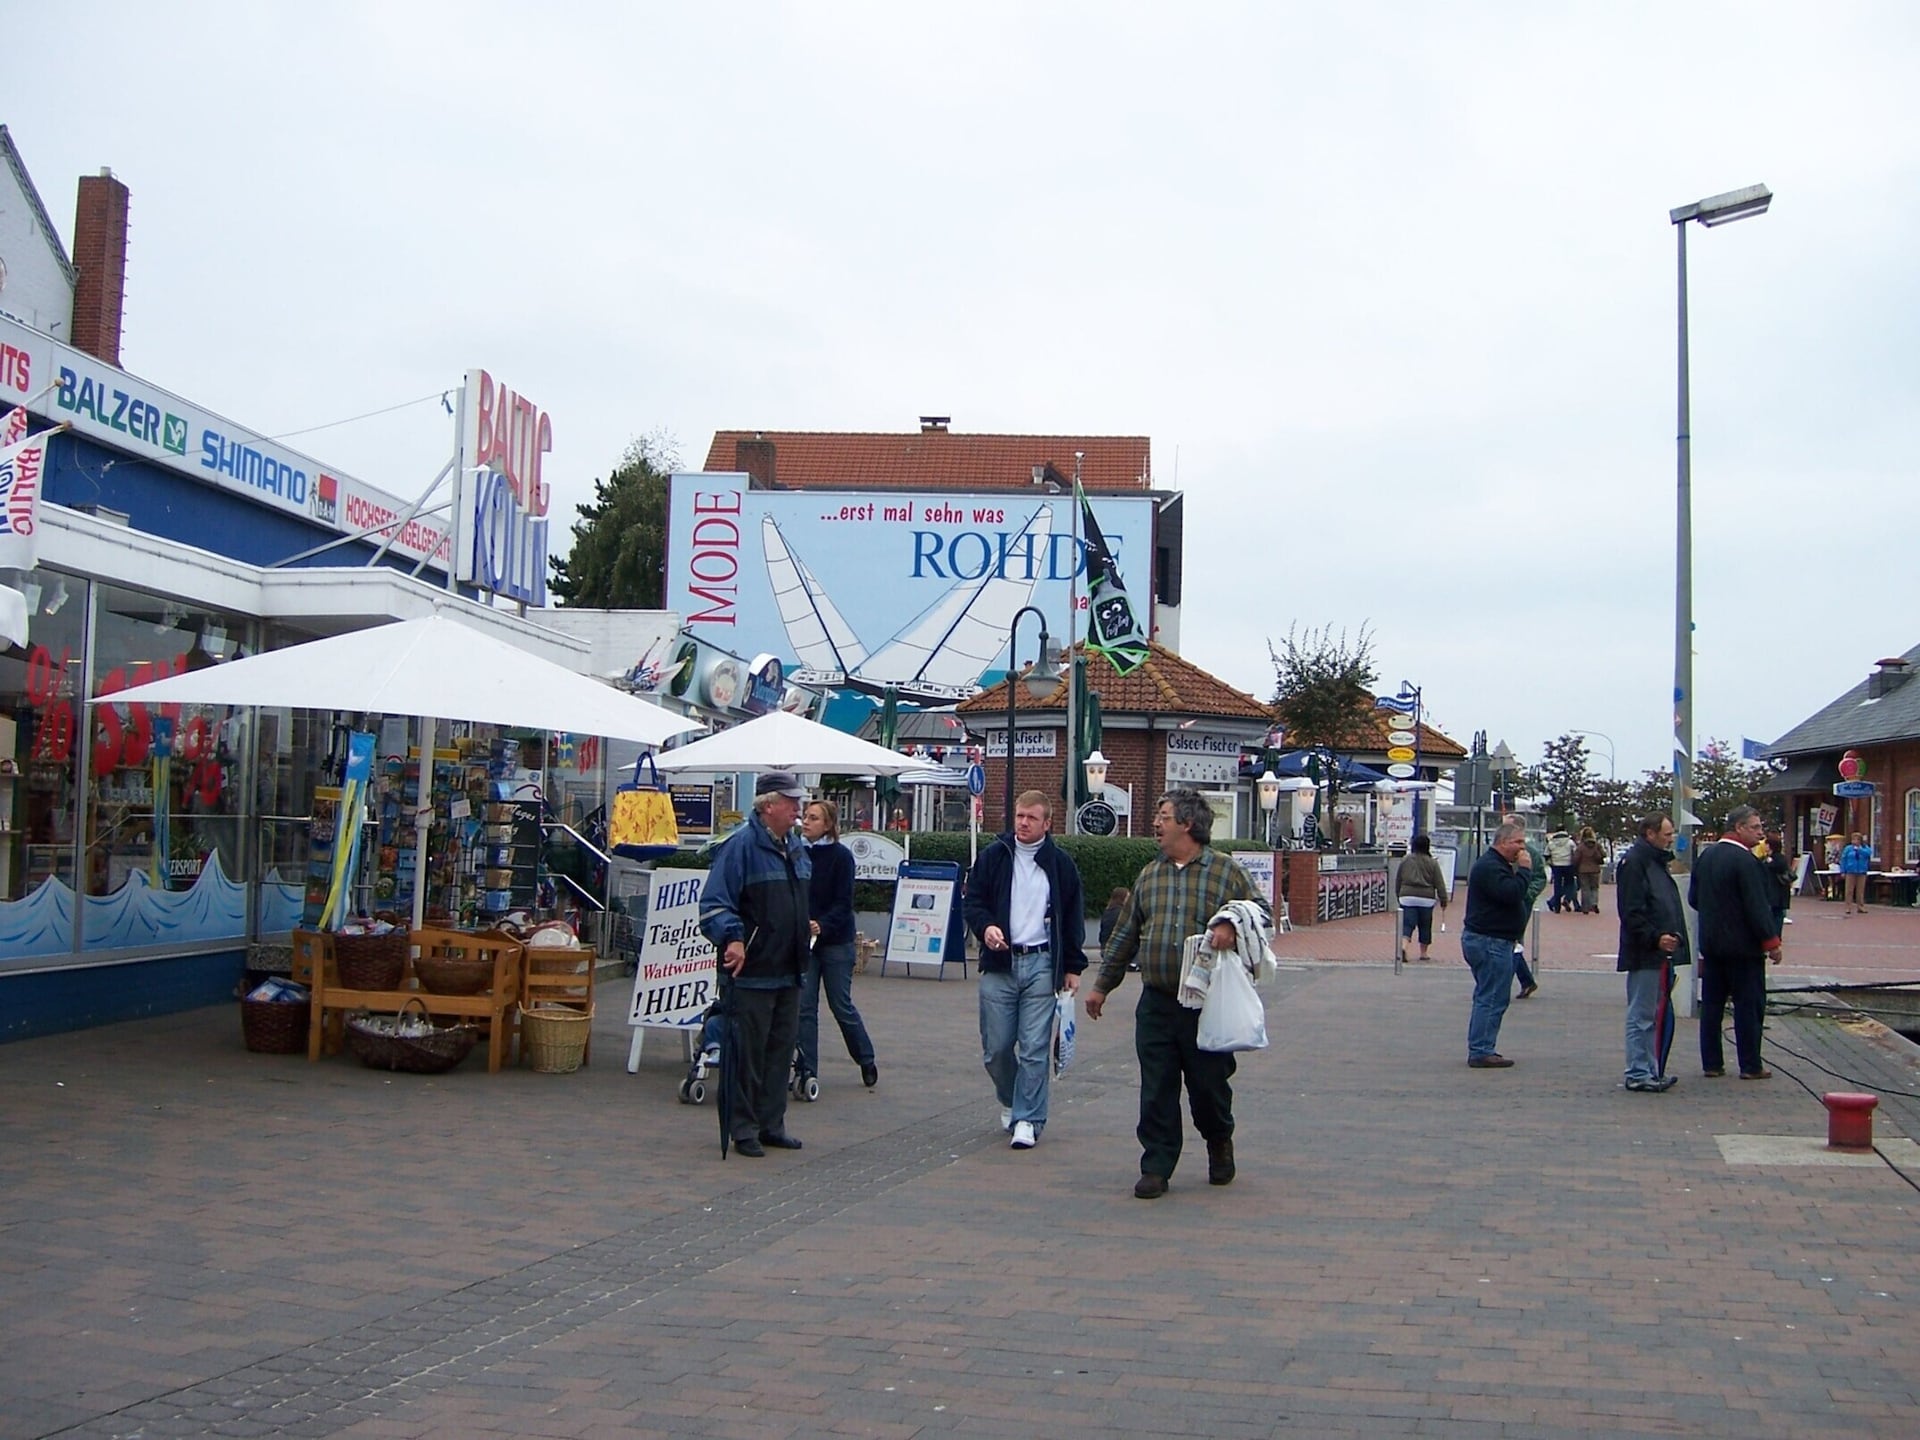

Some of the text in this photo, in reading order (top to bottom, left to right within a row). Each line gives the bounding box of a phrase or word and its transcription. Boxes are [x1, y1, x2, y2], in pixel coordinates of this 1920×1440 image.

[58, 366, 160, 446] BALZER
[477, 369, 552, 518] BALTIC
[201, 429, 306, 505] SHIMANO
[884, 501, 912, 522] mal
[925, 502, 963, 523] sehn
[974, 508, 1004, 523] was
[687, 490, 741, 627] MODE
[1819, 809, 1834, 822] EIS
[855, 864, 898, 876] garten
[655, 878, 701, 912] HIER
[650, 918, 701, 946] Täglic
